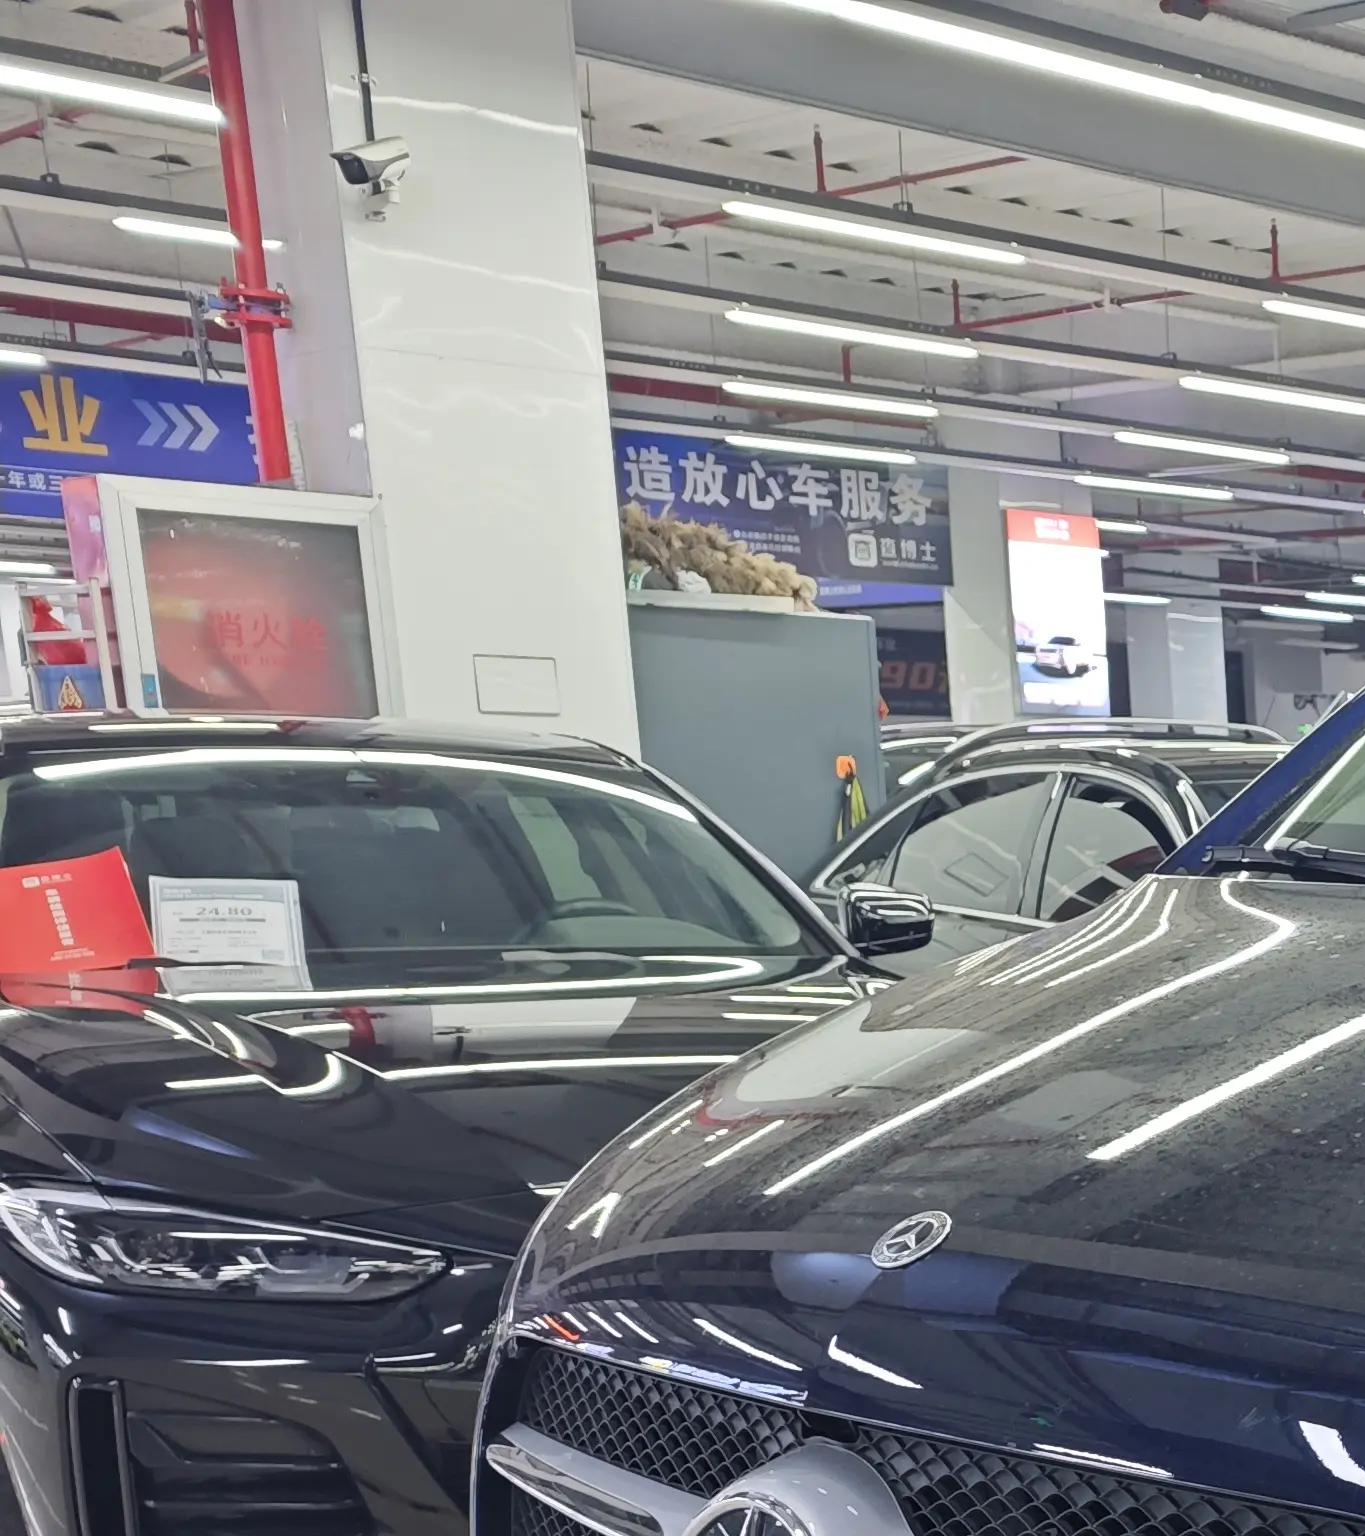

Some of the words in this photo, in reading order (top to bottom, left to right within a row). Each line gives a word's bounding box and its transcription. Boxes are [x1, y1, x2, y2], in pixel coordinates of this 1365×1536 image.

[19, 373, 109, 457] 业
[622, 444, 933, 528] 造放心车服务
